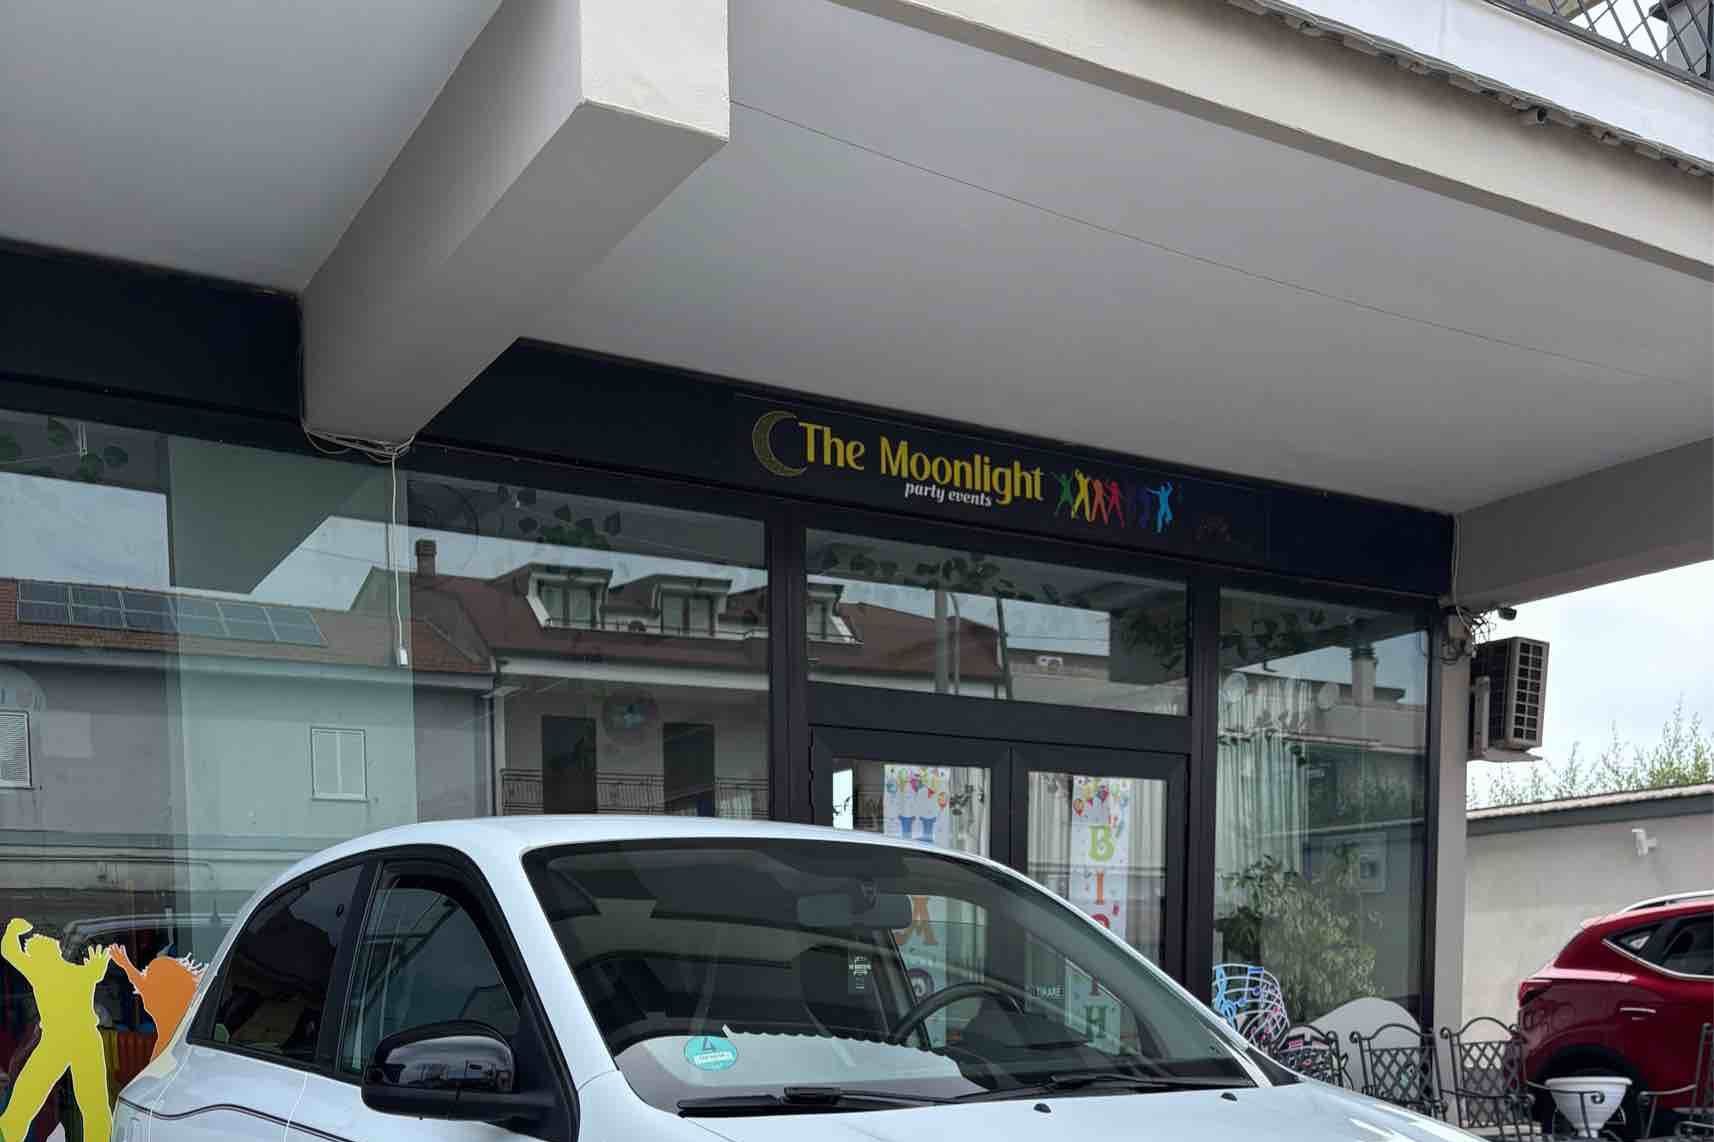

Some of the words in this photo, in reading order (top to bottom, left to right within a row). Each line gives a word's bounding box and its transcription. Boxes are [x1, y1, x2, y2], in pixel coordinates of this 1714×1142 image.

[799, 422, 865, 470] The
[879, 436, 1043, 505] Moonlight
[904, 483, 945, 503] party
[948, 491, 992, 507] events
